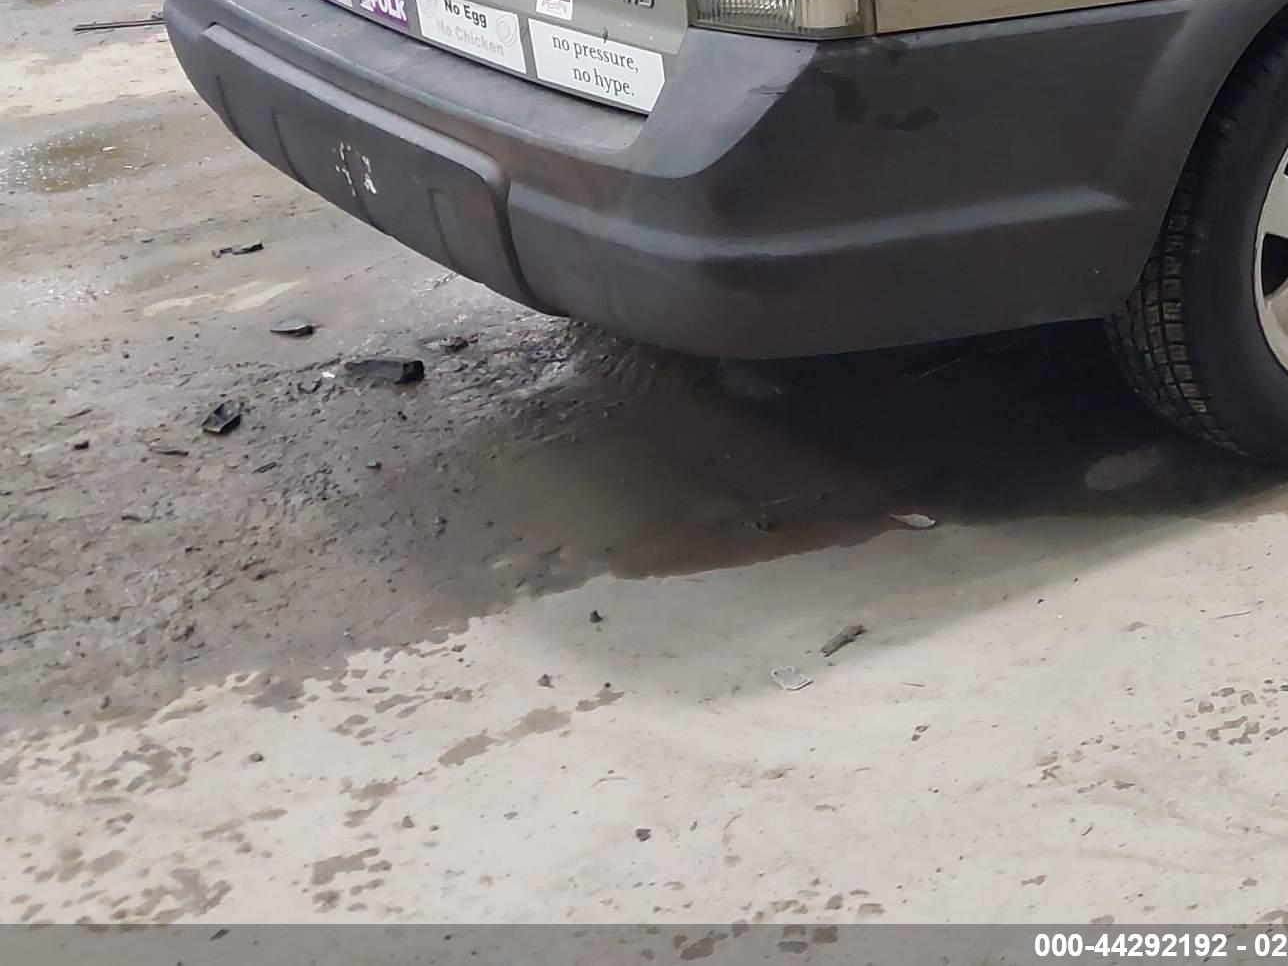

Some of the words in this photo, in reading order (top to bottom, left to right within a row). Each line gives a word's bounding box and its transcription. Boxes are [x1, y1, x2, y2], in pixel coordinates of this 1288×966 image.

[464, 4, 487, 28] Egg
[455, 25, 505, 57] Chicken
[552, 36, 570, 51] no
[573, 41, 639, 74] pressure,
[573, 67, 591, 83] no
[594, 68, 634, 96] hype.
